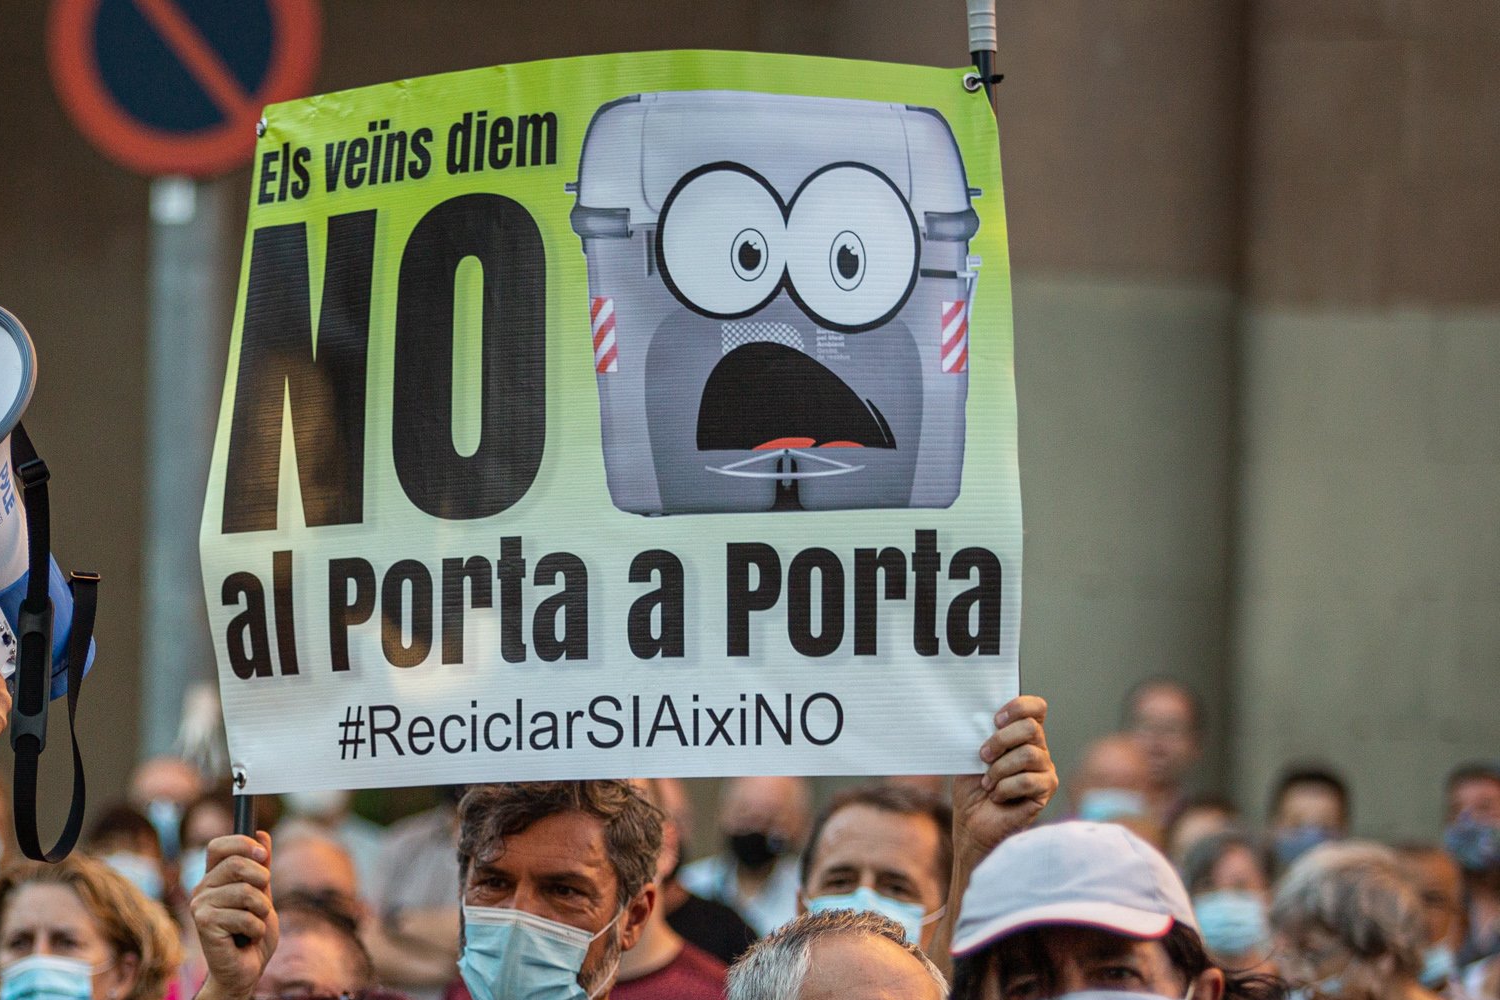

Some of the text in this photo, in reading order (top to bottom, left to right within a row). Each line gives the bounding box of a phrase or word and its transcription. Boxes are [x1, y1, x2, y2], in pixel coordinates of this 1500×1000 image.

[257, 110, 558, 205] Els veïns diem
[220, 191, 548, 535] NO
[220, 550, 300, 680] al
[627, 549, 685, 660] a
[337, 692, 844, 760] #ReciclarSIAixiNO
